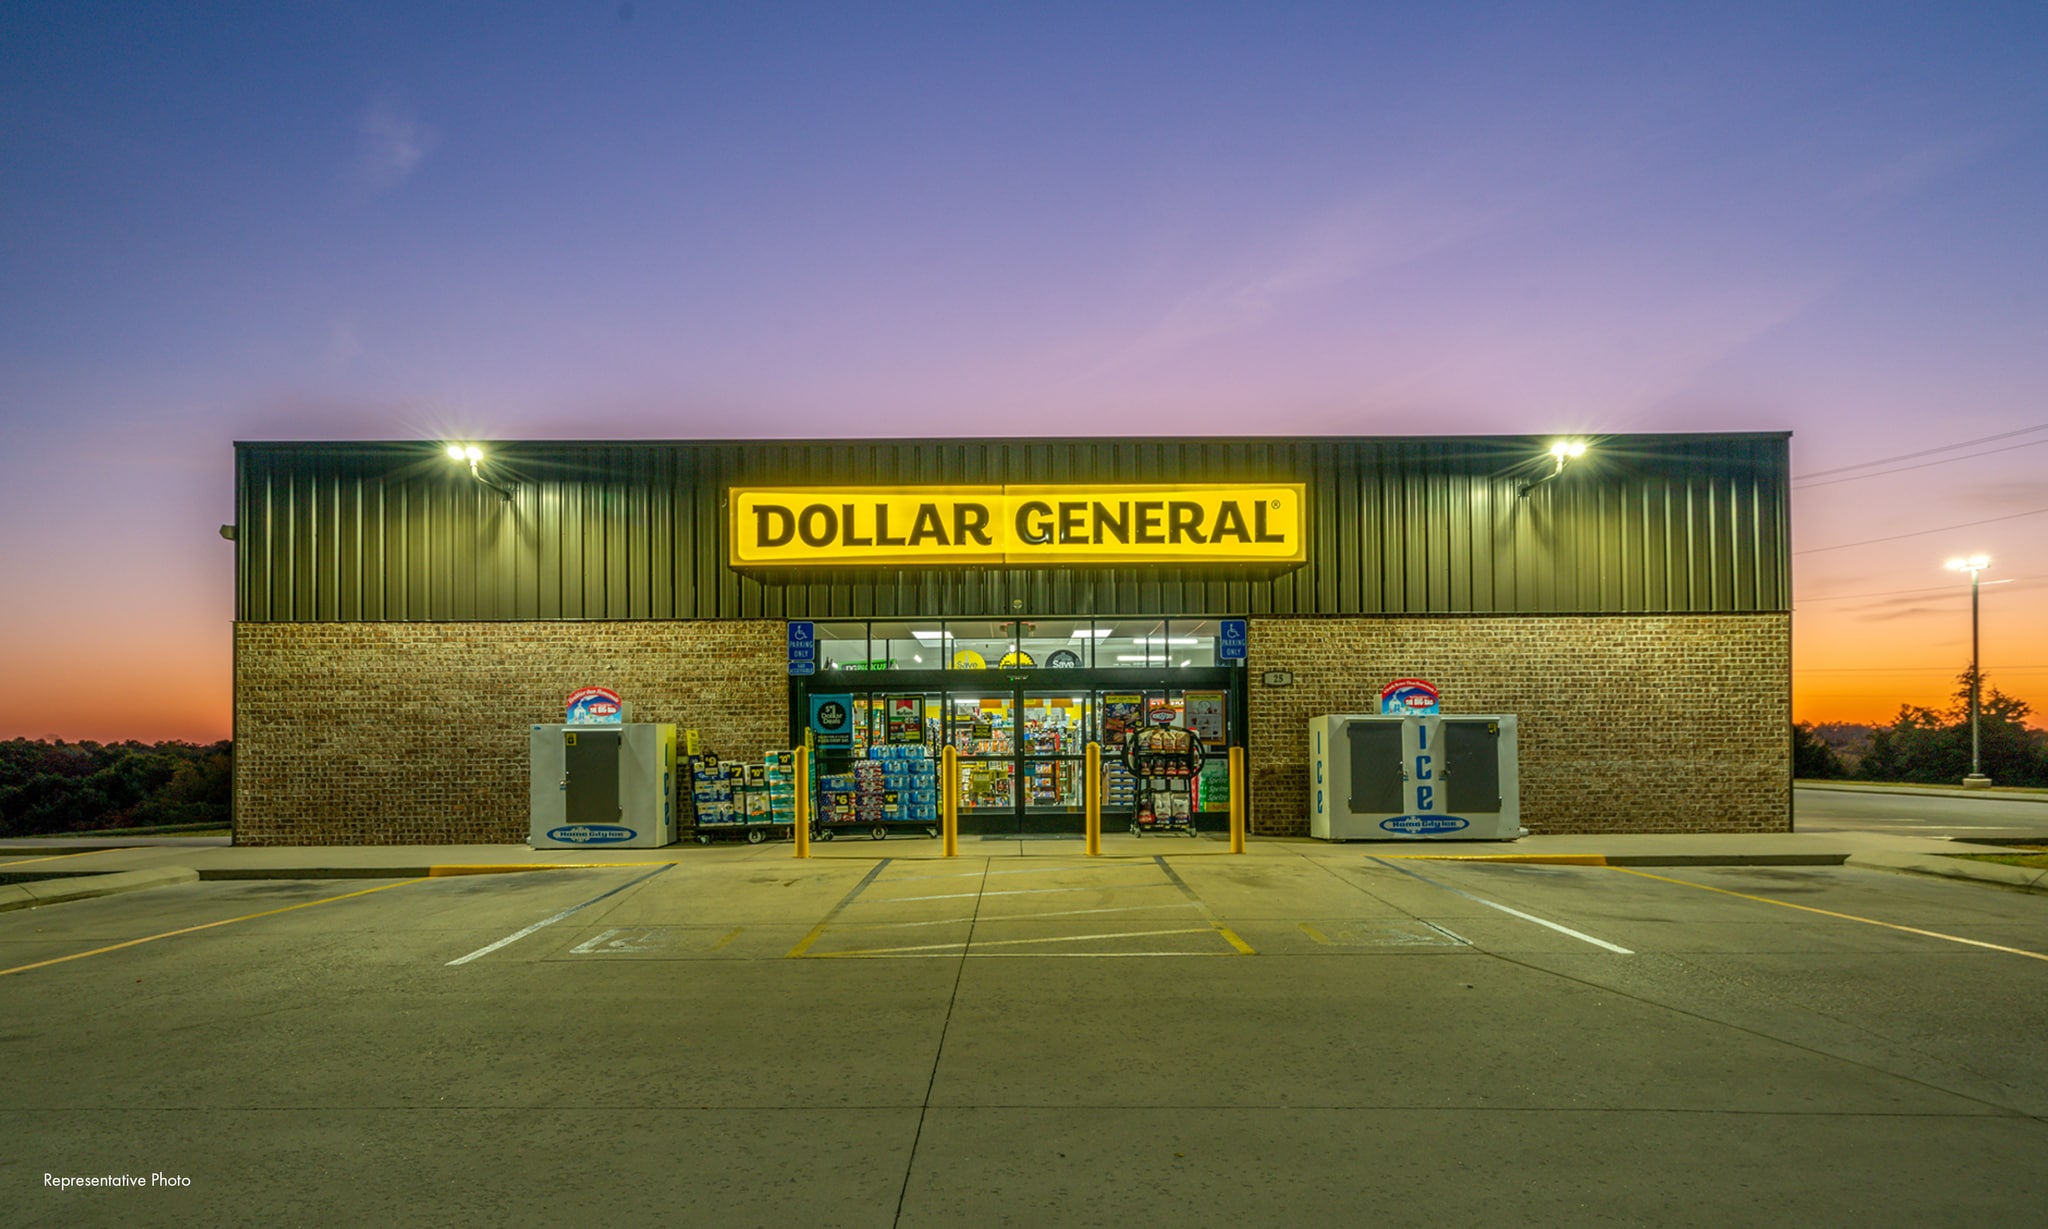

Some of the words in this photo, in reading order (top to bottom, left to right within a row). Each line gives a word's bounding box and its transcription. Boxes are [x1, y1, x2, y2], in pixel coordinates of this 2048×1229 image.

[752, 503, 993, 548] DOLLAR
[1015, 500, 1285, 545] GENERAL
[789, 640, 813, 648] PARKING
[793, 650, 808, 658] ONLY
[1226, 648, 1241, 656] ONLY
[956, 660, 978, 669] Save
[1052, 659, 1075, 669] Save
[1273, 674, 1284, 683] 25
[1422, 820, 1440, 828] City
